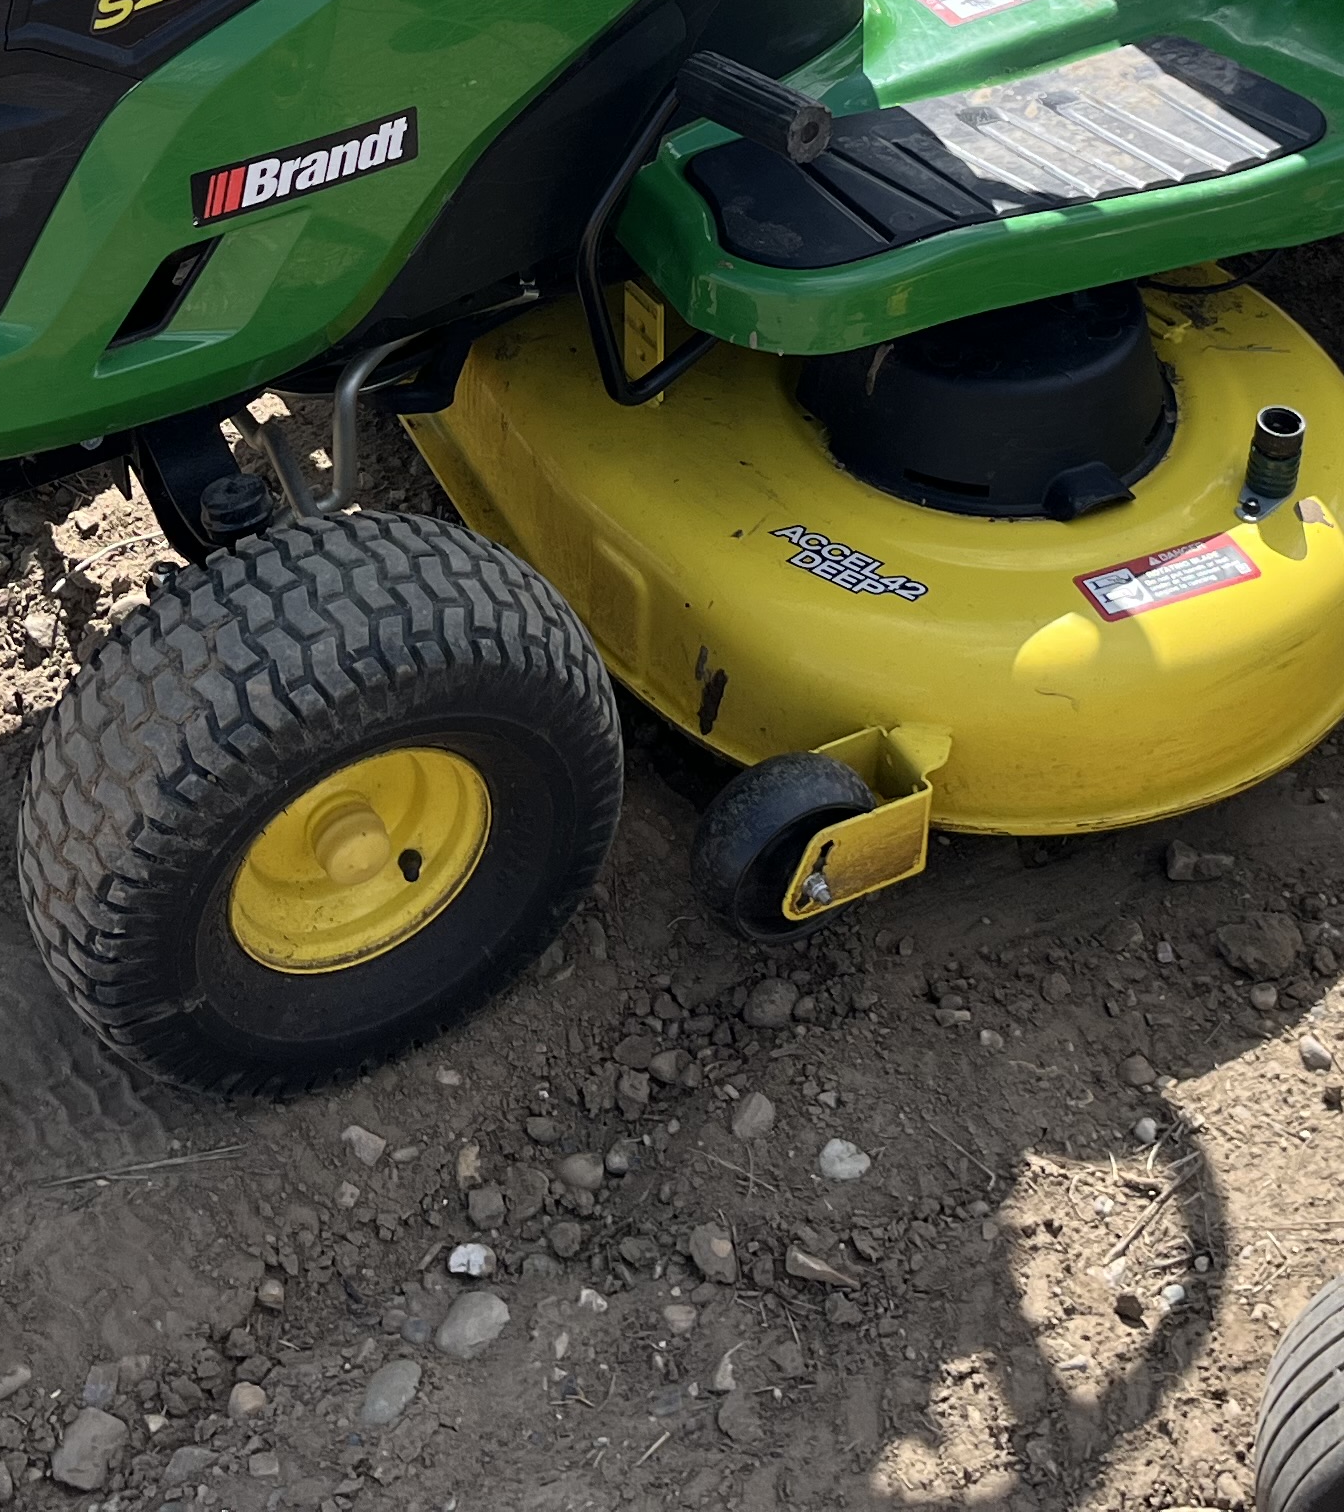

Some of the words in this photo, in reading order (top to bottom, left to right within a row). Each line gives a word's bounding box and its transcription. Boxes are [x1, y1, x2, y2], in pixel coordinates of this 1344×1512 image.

[241, 116, 409, 208] Brandt
[773, 526, 881, 581] ACCEL
[878, 576, 927, 601] 42
[789, 550, 885, 595] DEEP
[1157, 541, 1208, 563] DANGER
